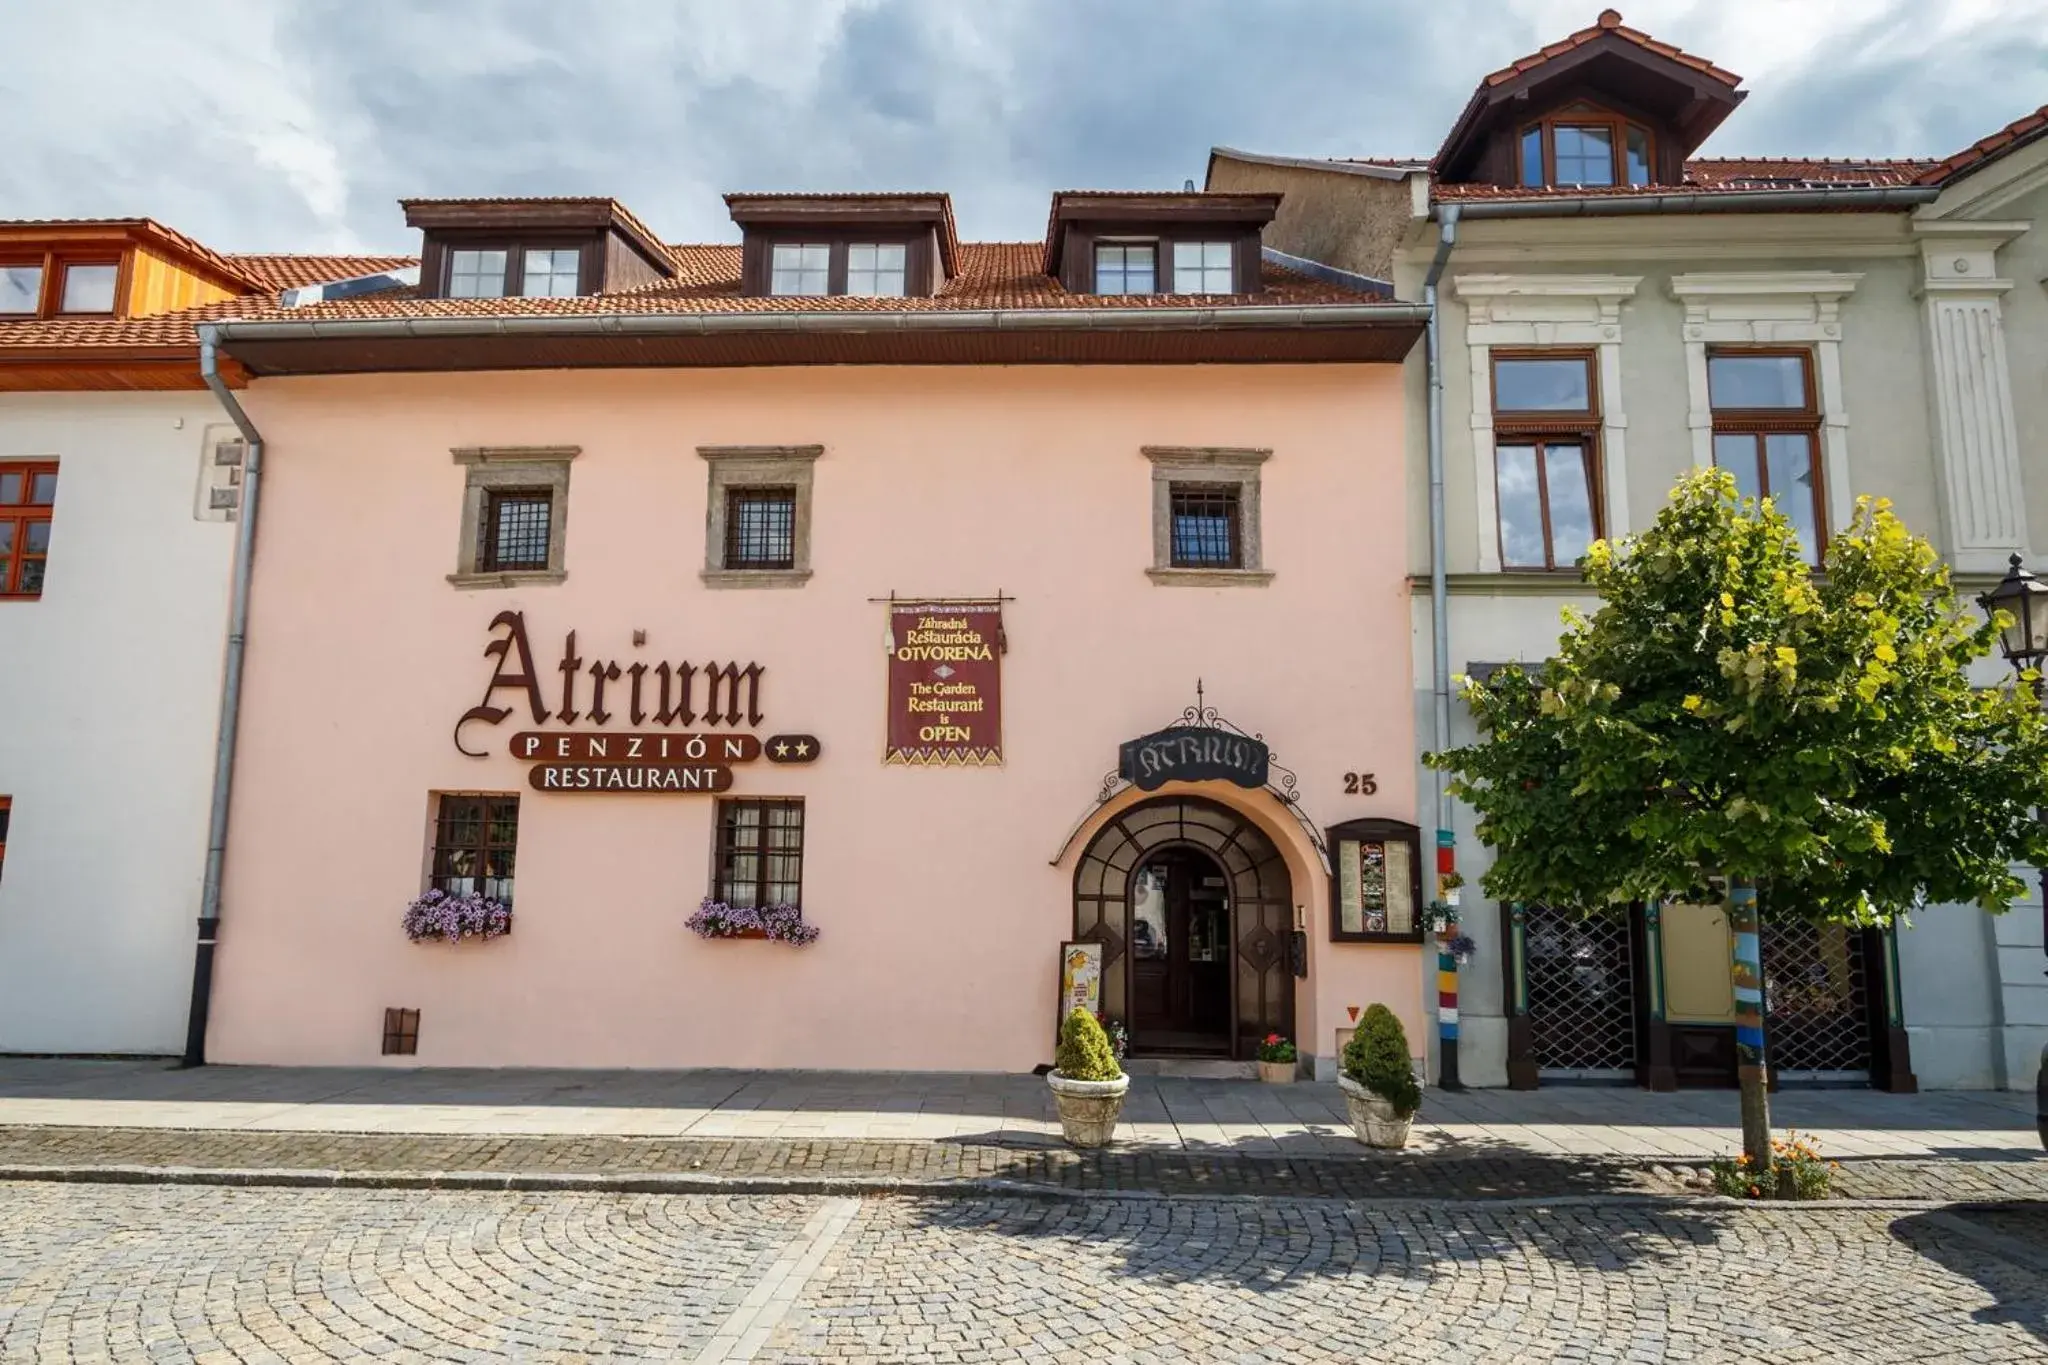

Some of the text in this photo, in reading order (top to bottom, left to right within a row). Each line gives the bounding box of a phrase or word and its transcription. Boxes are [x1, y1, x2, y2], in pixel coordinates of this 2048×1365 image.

[898, 644, 993, 661] OTVORENÁ
[454, 610, 766, 757] Atrium
[910, 682, 976, 697] The Garden
[908, 697, 983, 711] Restaurant
[940, 713, 949, 724] is
[919, 726, 971, 741] OPEN
[525, 734, 744, 758] PENZIÓN
[544, 767, 718, 789] RESTAURANT
[1343, 772, 1377, 796] 25
